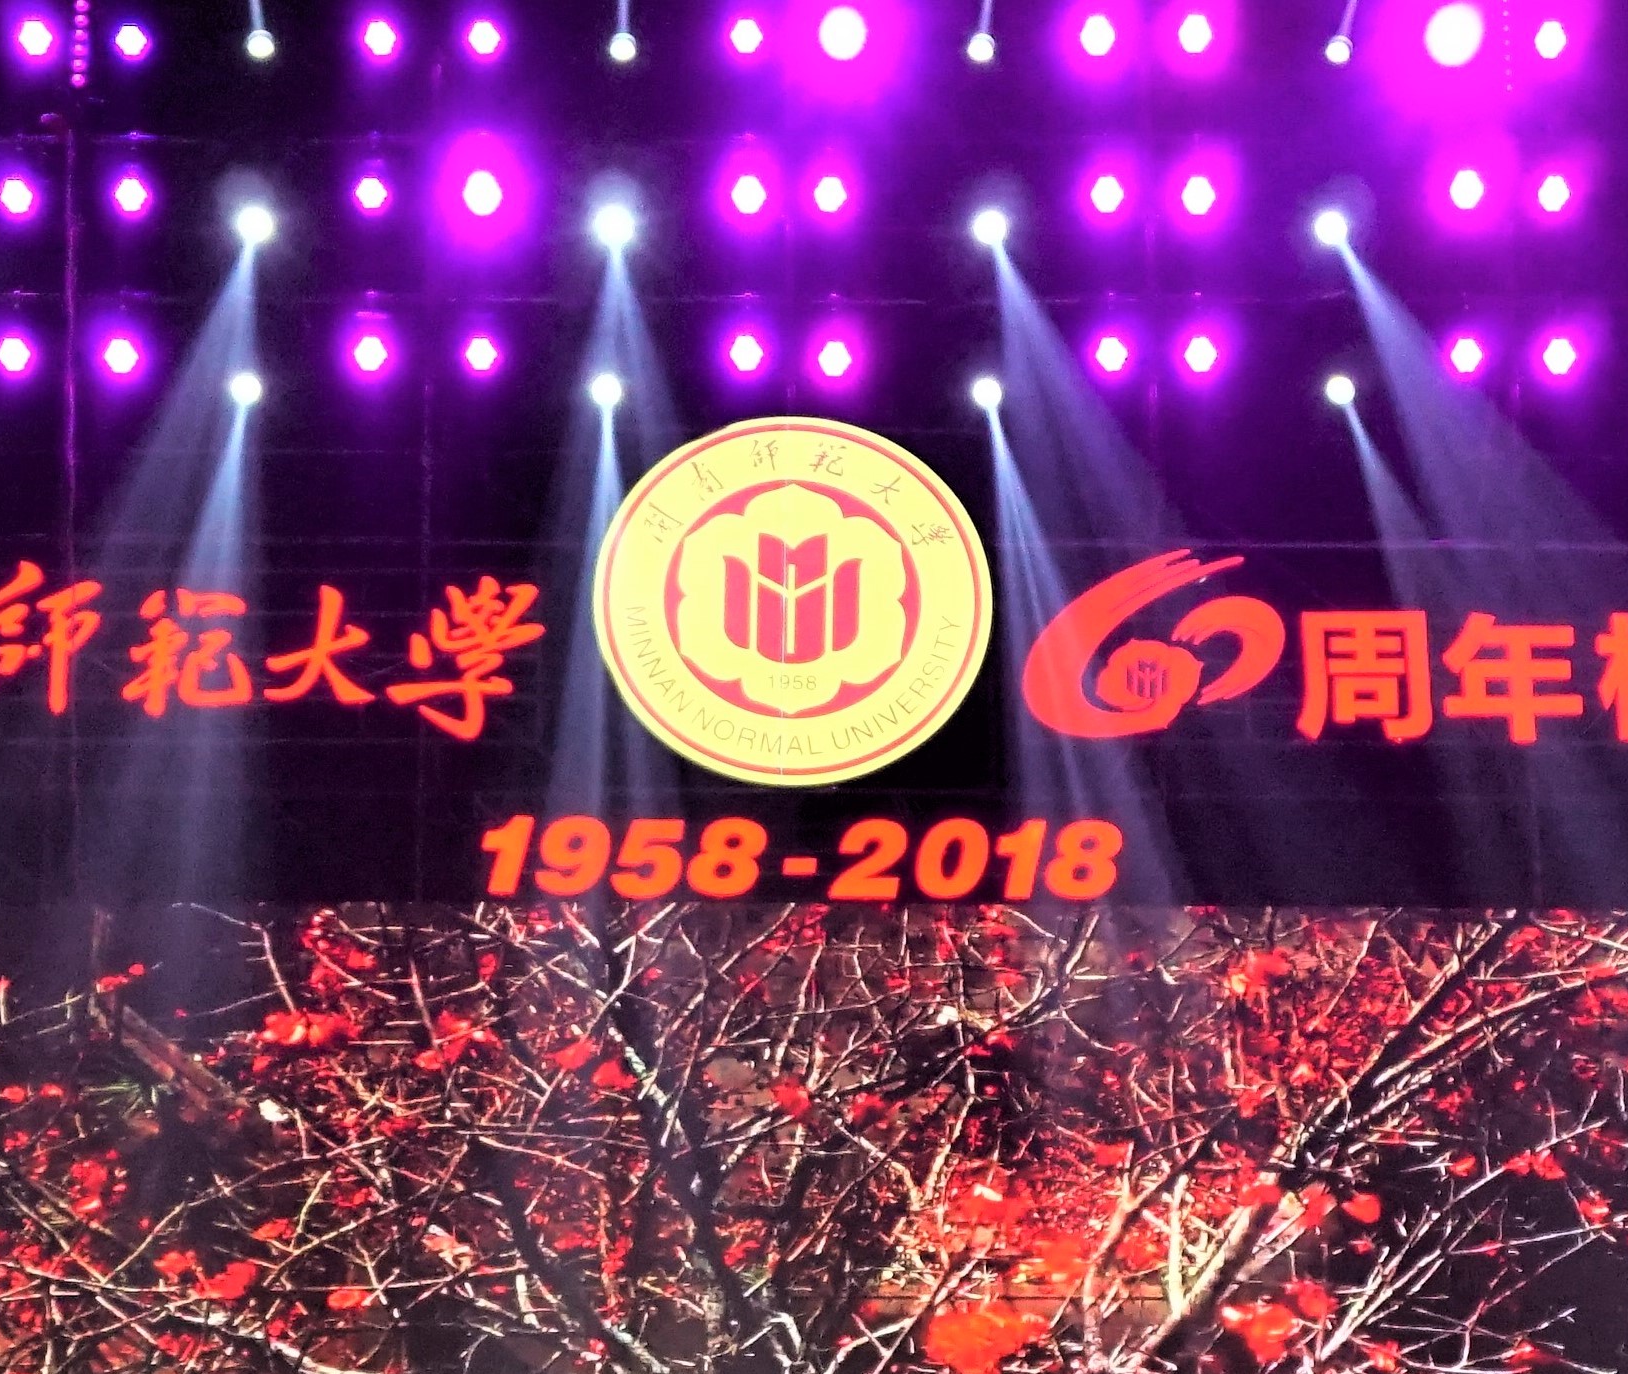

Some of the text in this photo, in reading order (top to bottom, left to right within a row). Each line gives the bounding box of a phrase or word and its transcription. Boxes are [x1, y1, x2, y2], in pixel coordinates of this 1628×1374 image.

[625, 604, 962, 756] MINNAN NORMAL UNIVERSITY
[767, 674, 818, 692] 1958
